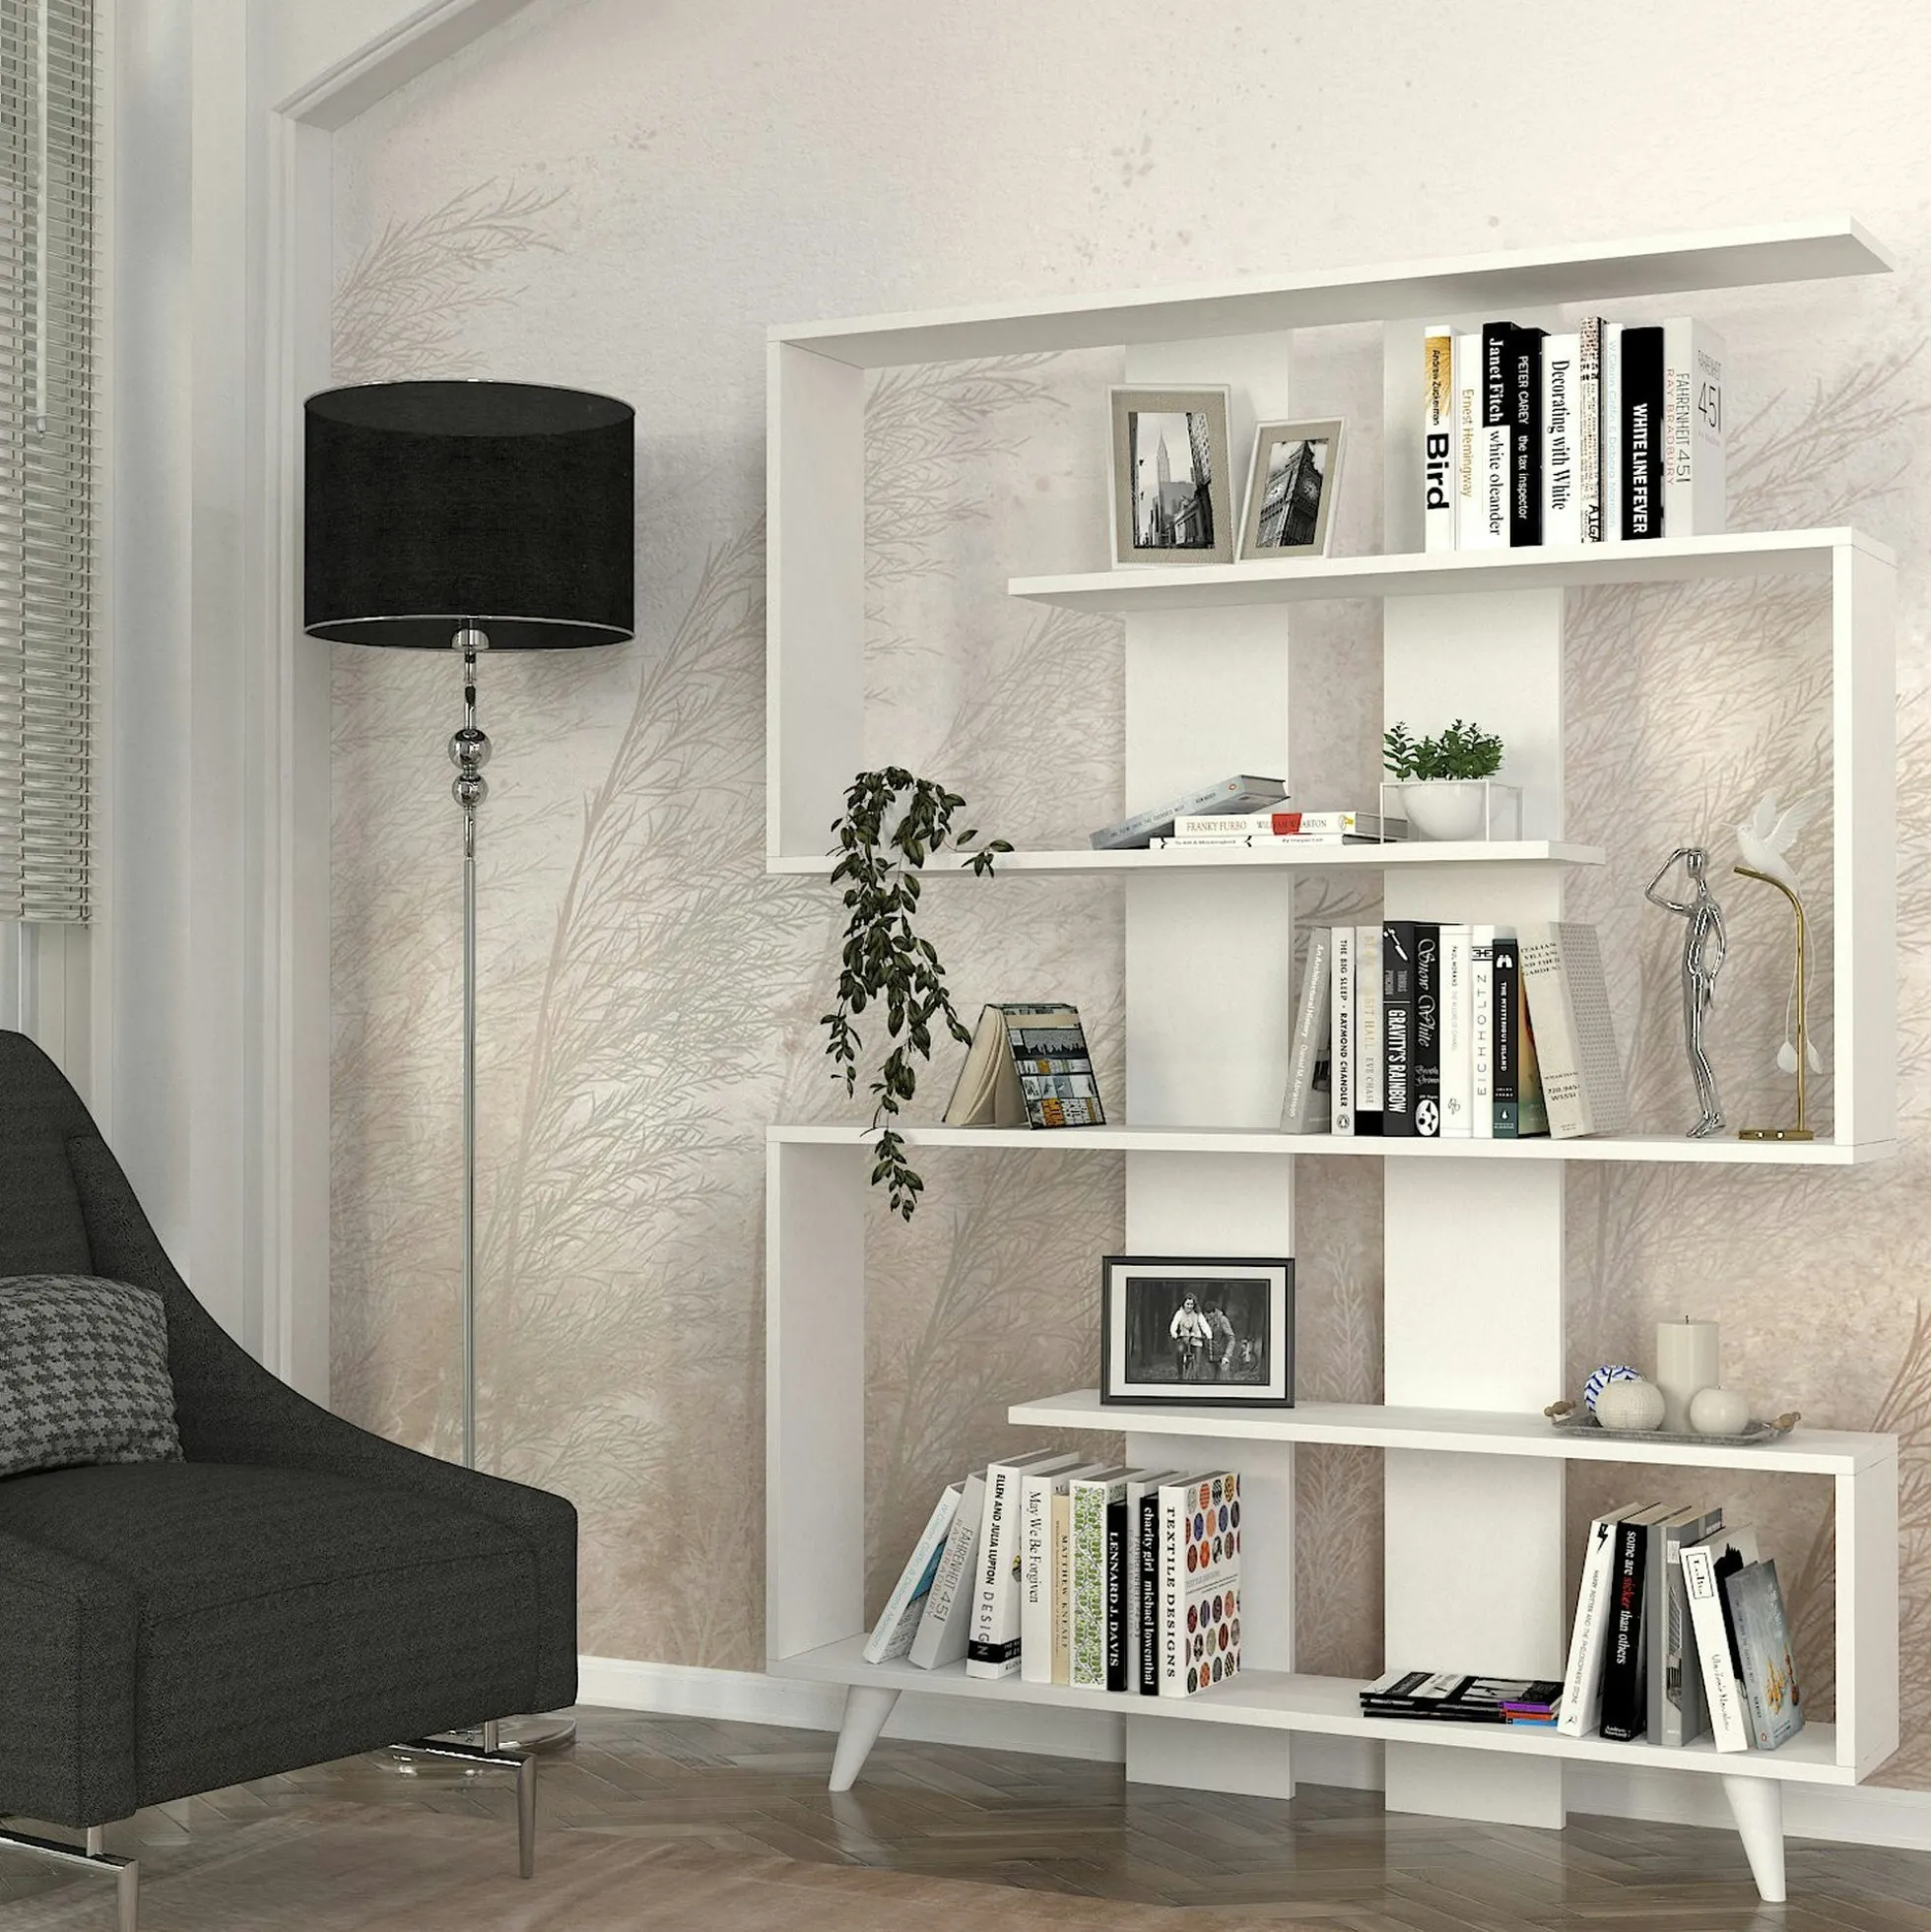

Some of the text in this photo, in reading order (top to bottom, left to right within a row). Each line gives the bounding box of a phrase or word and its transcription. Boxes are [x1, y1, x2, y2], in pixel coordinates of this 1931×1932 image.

[1489, 337, 1504, 424] Janet Fitch
[1517, 355, 1529, 425] PETER CAREY
[1666, 368, 1675, 486] RAY BRADBURY
[1675, 372, 1692, 484] FAHRENHEIT 451
[1427, 433, 1450, 510] Bird
[1459, 388, 1475, 499] Ernest Hemingway
[1489, 431, 1504, 536] white oleander
[1516, 434, 1530, 520] the tax inspector
[1547, 360, 1571, 511] Decorating with White
[1631, 403, 1648, 534] WHITE LINE FEVER
[1185, 821, 1247, 833] FRANKY FURBO
[1339, 939, 1349, 1002] THE BIG SLEEP
[1418, 938, 1436, 991] Snow
[1339, 1012, 1349, 1108] RAYMOND CHANDLER
[1387, 1009, 1408, 1113] GRAVITY'S RAINBOW
[1418, 994, 1436, 1047] White
[1477, 974, 1488, 1097] EICHHOLTZ
[1499, 997, 1508, 1043] MYSTERIOUS
[1499, 1044, 1508, 1072] ISLAND
[1365, 1075, 1375, 1105] CHASE
[943, 1526, 974, 1590] FAHRENHEIT
[950, 1517, 964, 1545] RAY
[985, 1473, 1006, 1585] ELLEN AND JULIA LUPTON
[1026, 1491, 1042, 1604] May We Be Forgiven
[975, 1591, 995, 1656] DESIGN
[1109, 1531, 1119, 1667] LENNARD J. DAVIS
[1142, 1506, 1156, 1686] charity girl michael lowenthal
[1166, 1506, 1176, 1678] TEXTILE DESIGNS
[1616, 1530, 1636, 1665] some are sicker than others
